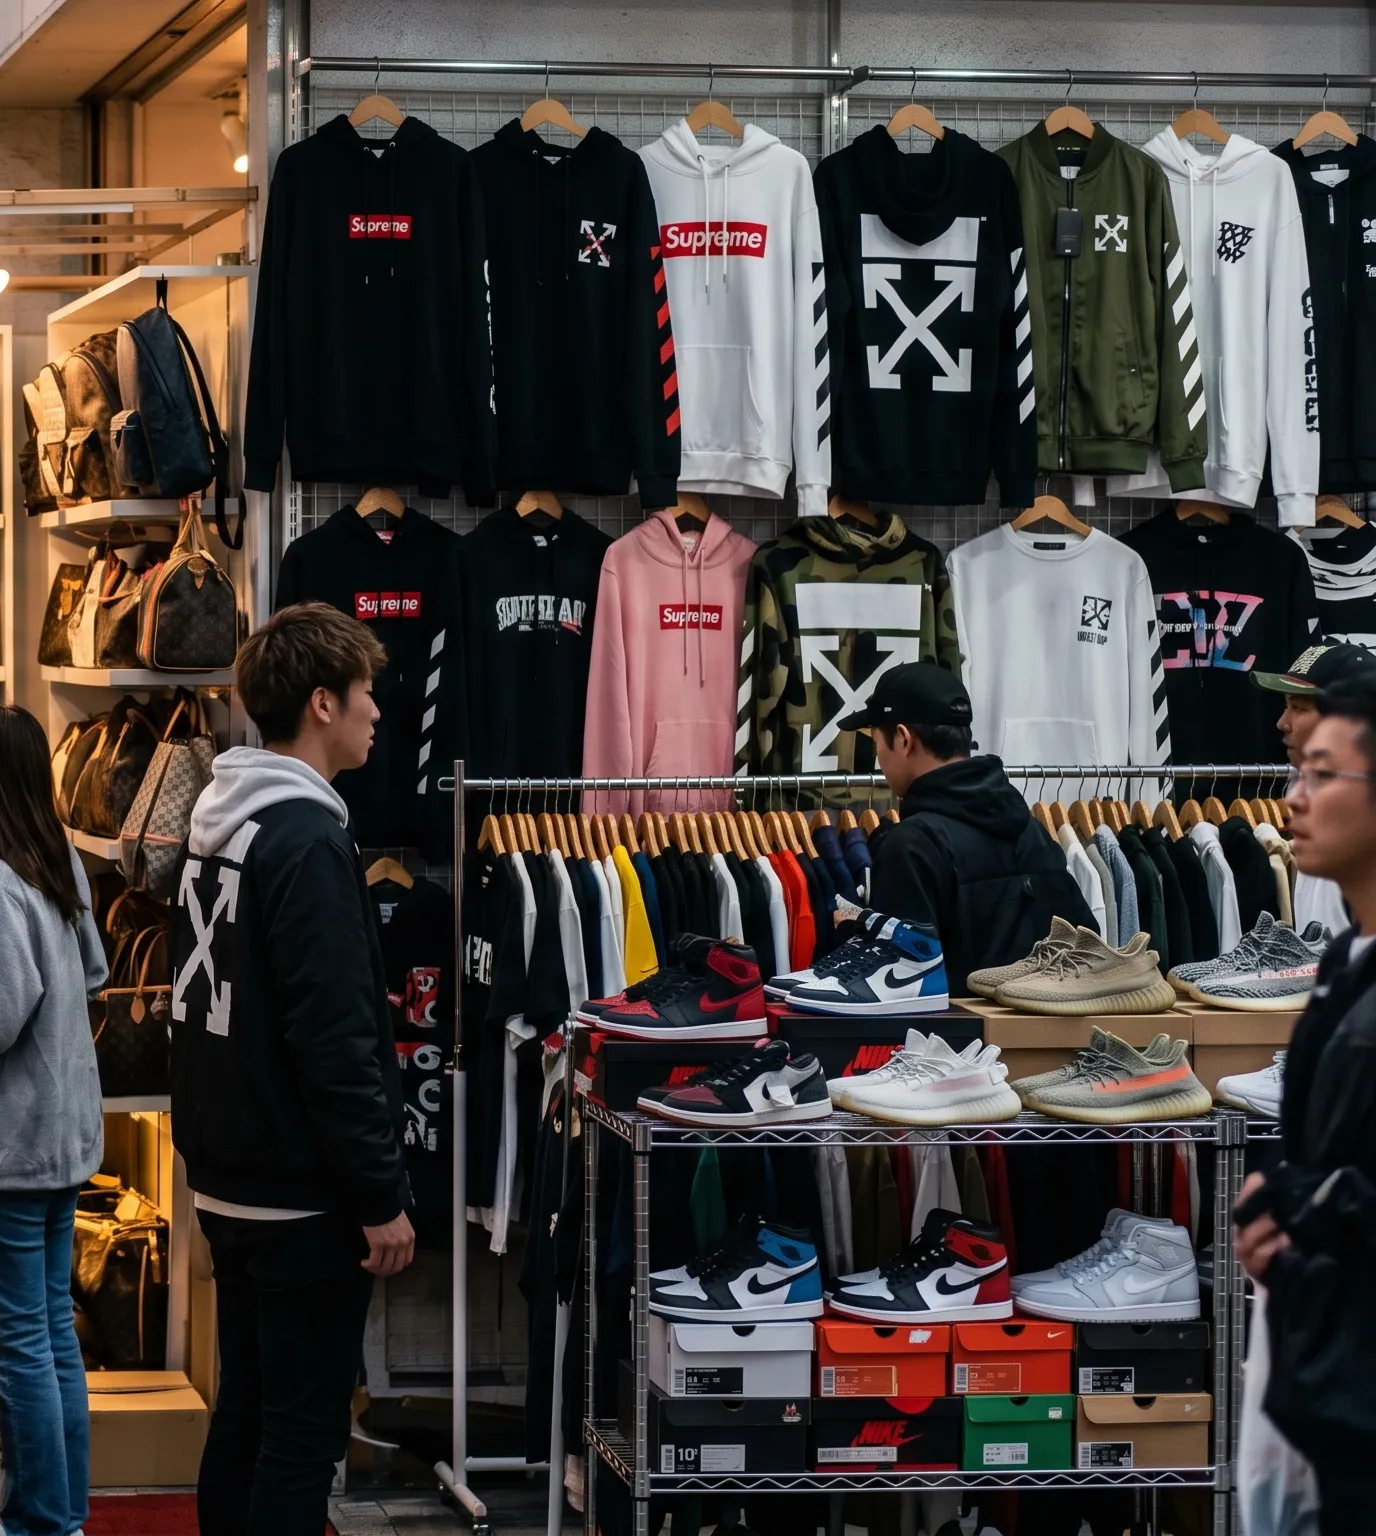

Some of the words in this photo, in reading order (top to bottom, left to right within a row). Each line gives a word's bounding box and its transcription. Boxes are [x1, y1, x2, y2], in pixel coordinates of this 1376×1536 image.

[351, 217, 409, 234] Supreme
[665, 226, 763, 254] Supreme
[663, 607, 720, 627] Supreme
[852, 1045, 904, 1069] NIK
[858, 1420, 909, 1446] NIKE
